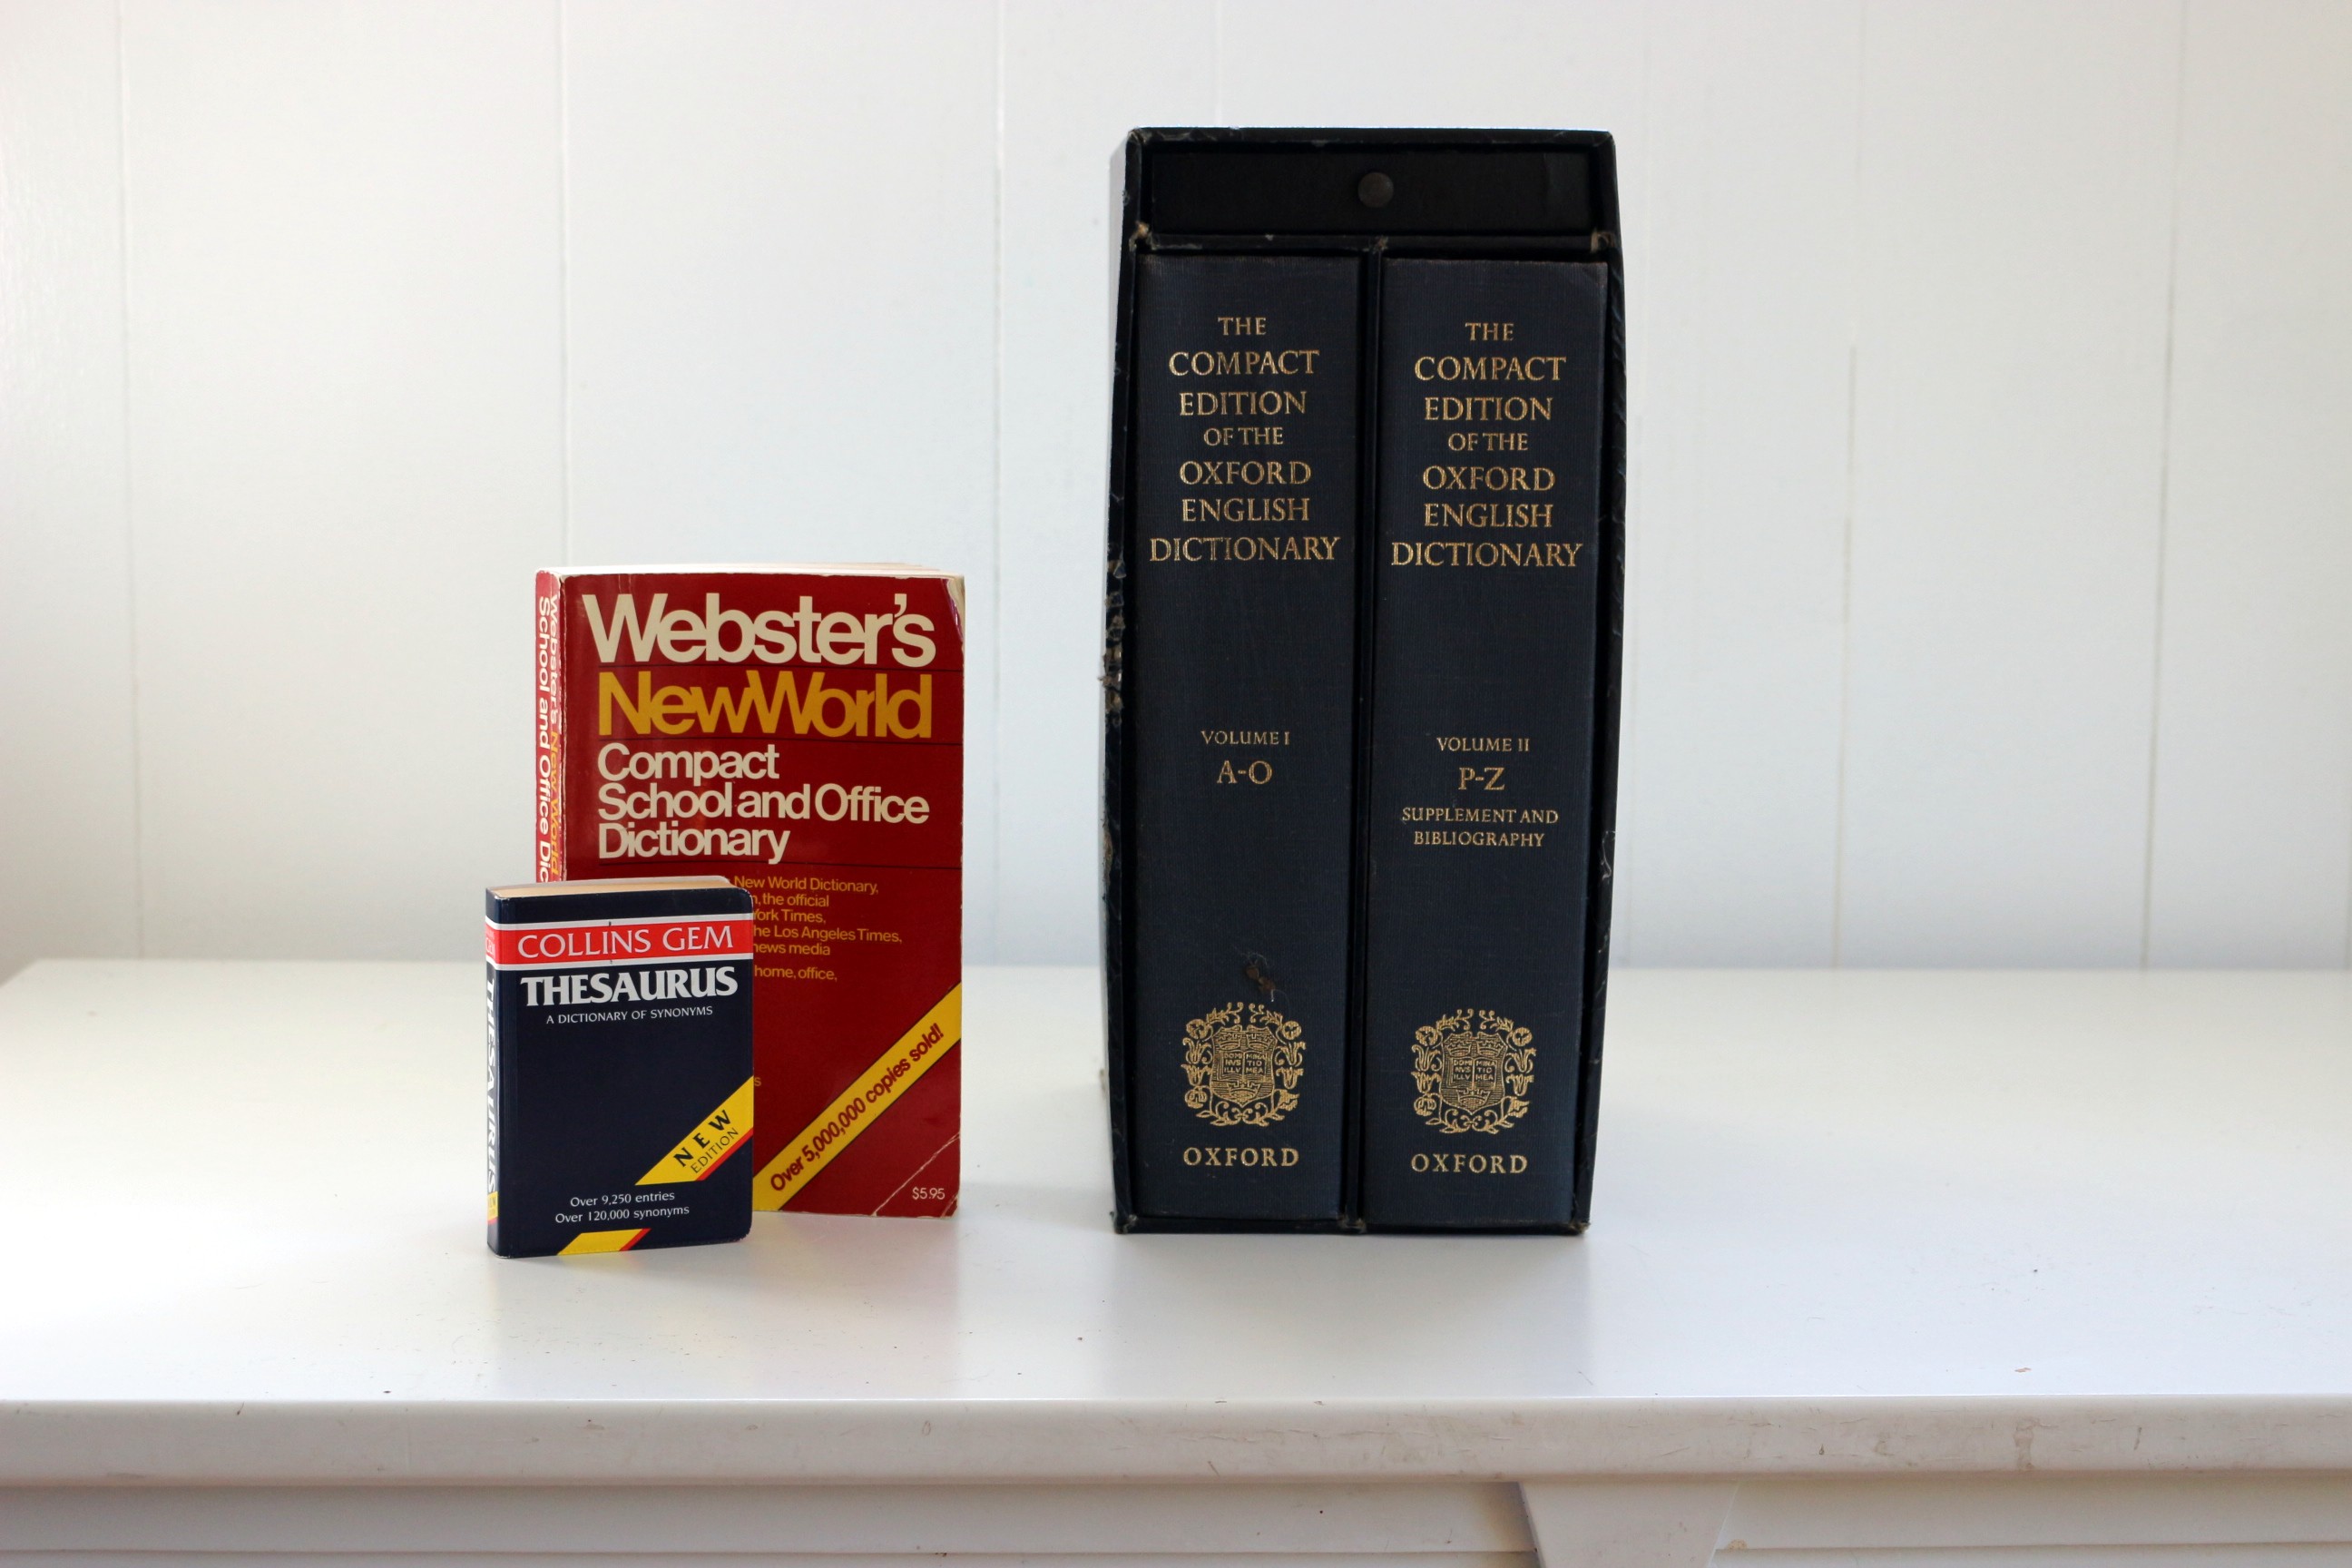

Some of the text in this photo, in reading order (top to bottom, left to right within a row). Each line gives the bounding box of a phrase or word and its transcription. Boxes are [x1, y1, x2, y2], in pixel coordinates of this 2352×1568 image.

[1218, 317, 1267, 336] THE
[1465, 322, 1514, 341] THE
[1169, 349, 1320, 377] COMPACT
[1415, 356, 1566, 381] COMPACT
[1179, 391, 1308, 416] EDITION
[1425, 397, 1553, 421] EDITION
[1203, 426, 1284, 446] OF THE
[1448, 433, 1528, 452] OF THE
[1179, 460, 1312, 486] OXFORD
[1423, 466, 1556, 492] OXFORD
[1181, 497, 1309, 523] ENGLISH
[1425, 503, 1553, 528] ENGLISH
[1150, 536, 1340, 563] DICTIONARY
[1391, 542, 1583, 567] DICTIONARY
[583, 593, 936, 667] Webster's
[539, 595, 551, 691] School
[539, 705, 551, 750] and
[1200, 730, 1279, 745] VOLUME
[1436, 737, 1530, 752] VOLUME II
[598, 742, 779, 786] Compact
[1217, 760, 1272, 785] A-O
[1458, 767, 1505, 790] P-Z
[539, 755, 551, 835] Office
[598, 782, 929, 824] School and Office
[1402, 807, 1558, 824] SUPPLEMENT AND
[599, 822, 790, 864] Dictionary
[1414, 831, 1544, 847] BIBLIOGRAPHY
[734, 876, 878, 896] New World Dictionary,
[762, 893, 784, 906] the
[787, 894, 829, 907] official
[781, 909, 826, 925] Times,
[517, 928, 652, 958] COLLINS
[662, 926, 733, 952] GEM
[774, 926, 799, 938] Los
[801, 926, 856, 942] Angeles
[857, 928, 902, 944] Times,
[789, 943, 830, 956] media
[754, 965, 838, 981] home, office,
[520, 966, 738, 1006] THESAURUS
[546, 1005, 713, 1024] A DICTIONARY OF SYNONYMS
[770, 1023, 945, 1191] Over 5,000,000 copies sold!
[691, 1127, 739, 1173] EDITION
[1183, 1147, 1299, 1168] OXFORD
[1411, 1153, 1528, 1174] OXFORD
[570, 1191, 675, 1207] Over 9,250 entries
[912, 1186, 946, 1200] $5.95
[555, 1206, 690, 1223] Over 120,000 synonyms
